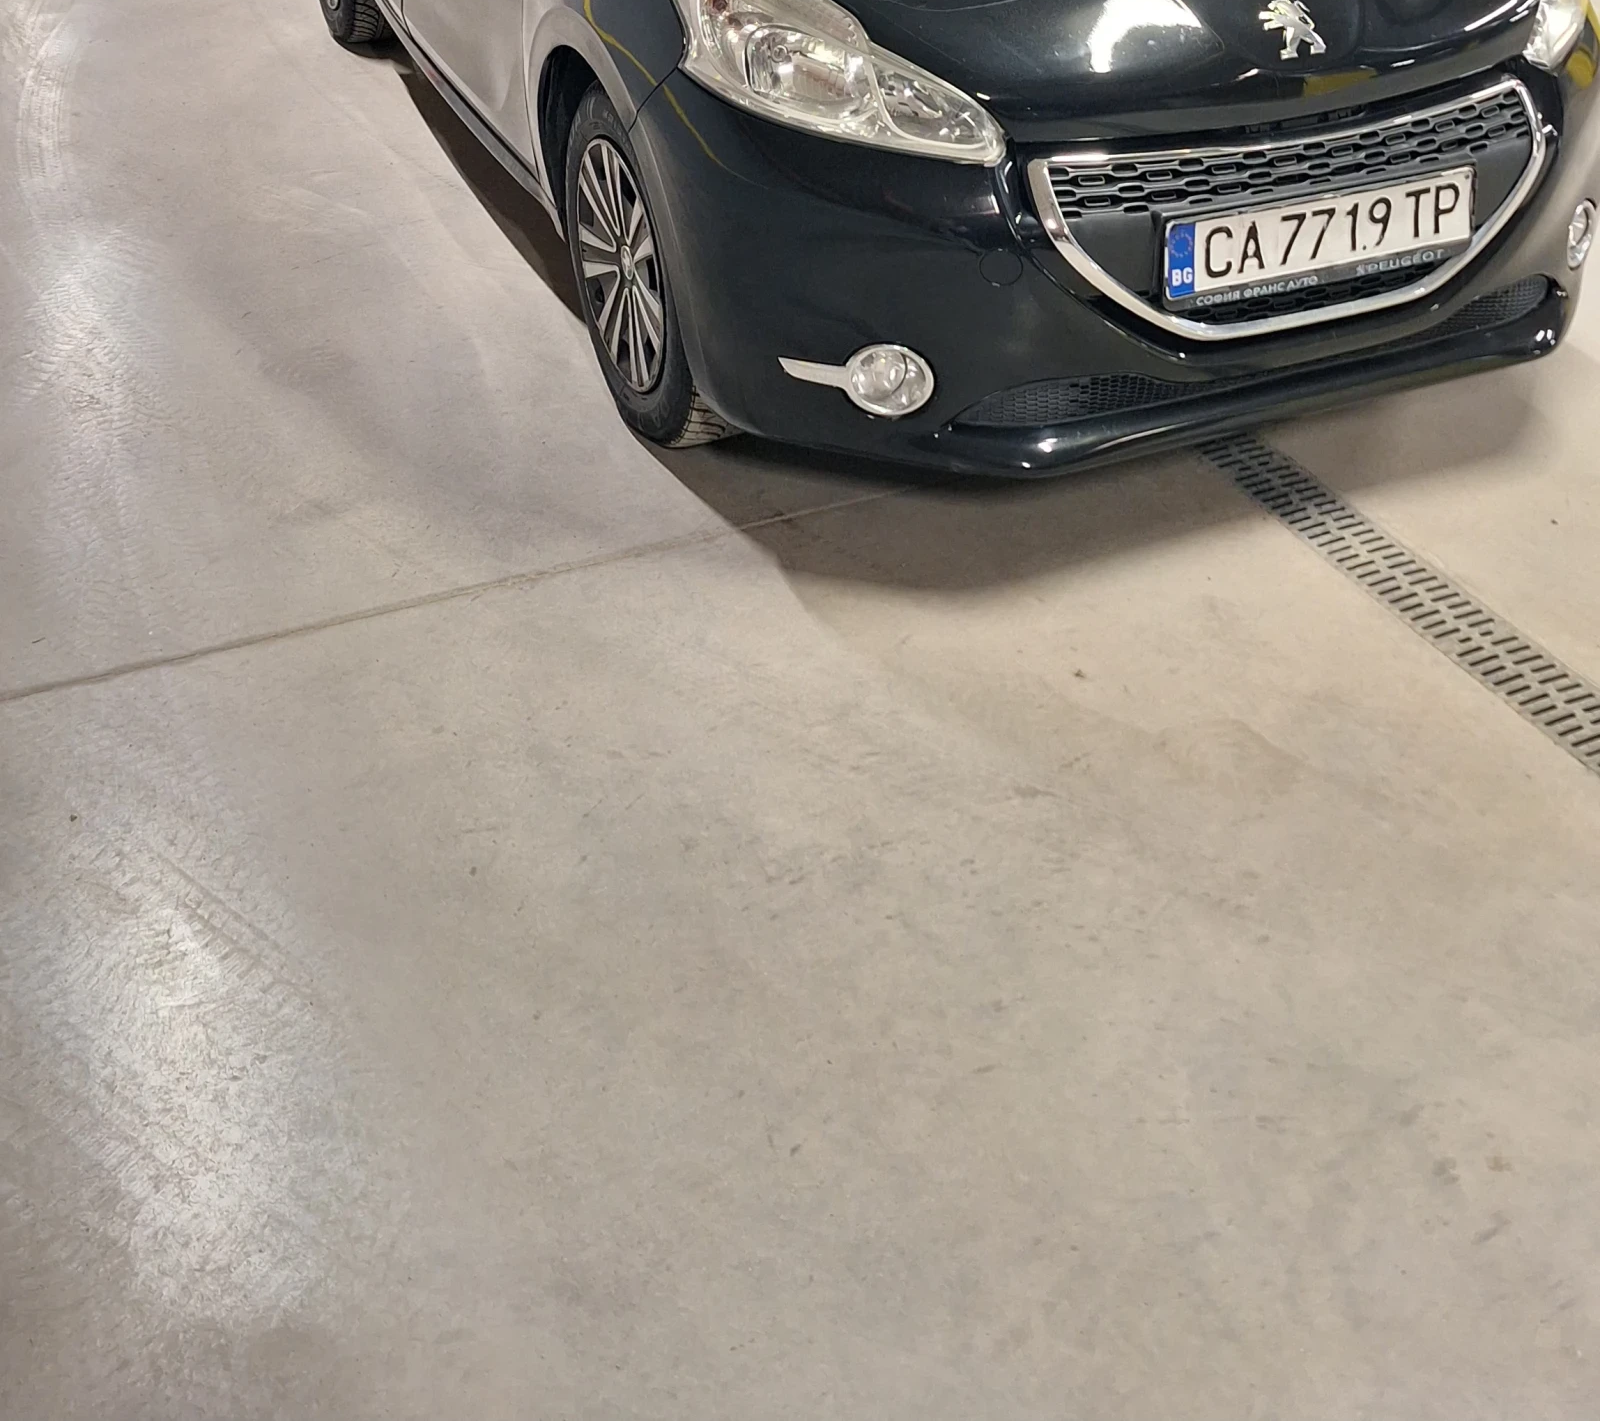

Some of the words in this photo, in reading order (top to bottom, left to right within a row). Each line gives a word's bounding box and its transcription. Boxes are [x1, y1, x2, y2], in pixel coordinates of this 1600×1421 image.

[1205, 220, 1265, 278] CA
[1279, 197, 1392, 266] 7719
[1405, 182, 1460, 238] TP
[1367, 249, 1444, 273] PEUGEOT
[1171, 267, 1193, 287] BG
[1196, 290, 1240, 306] СОФИЯ
[1286, 275, 1319, 292] АУТО
